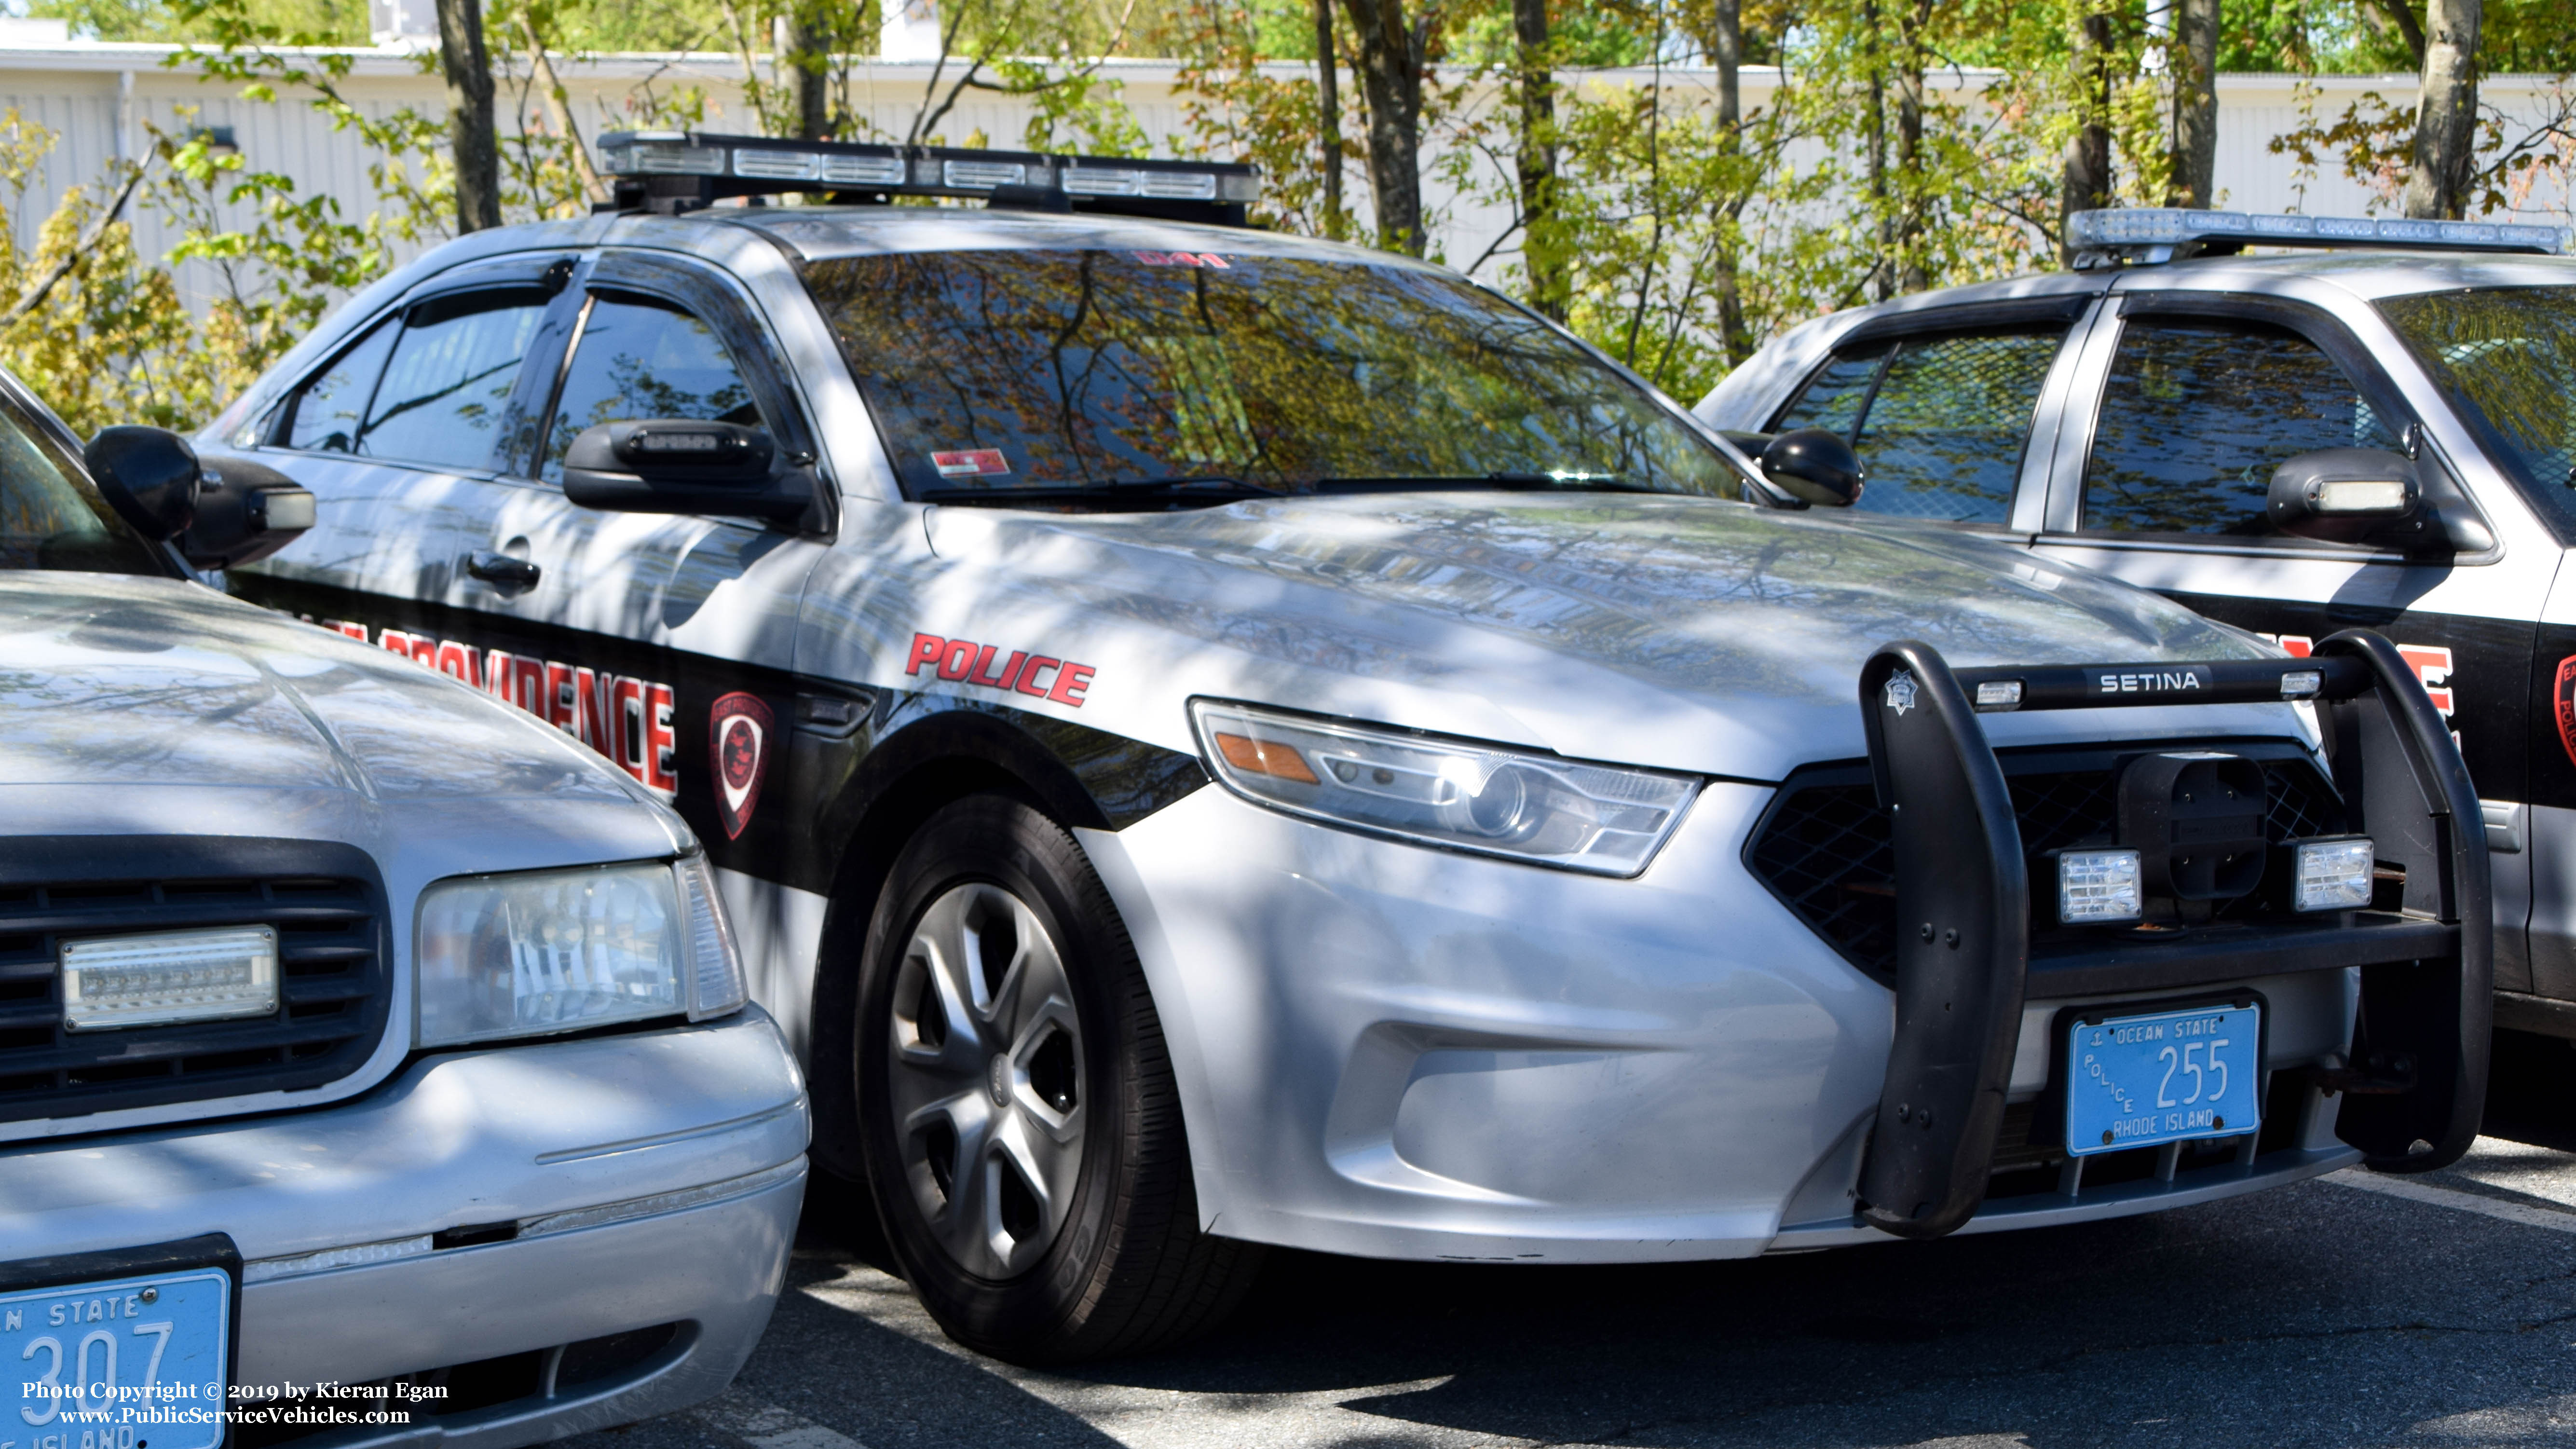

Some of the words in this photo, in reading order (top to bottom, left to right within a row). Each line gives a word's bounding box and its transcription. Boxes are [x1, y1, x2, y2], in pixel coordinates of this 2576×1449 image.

[905, 632, 1096, 708] POLICE
[2100, 672, 2200, 692] SETINA
[379, 629, 678, 800] IDENCE
[2561, 700, 2576, 752] POLIC
[2117, 1025, 2164, 1045] OCEAN
[2175, 1017, 2217, 1038] STATE
[2084, 1053, 2134, 1114] POLICE
[2156, 1039, 2229, 1108] 255
[2113, 1115, 2158, 1138] RHODE
[2166, 1108, 2213, 1132] ISLAND
[50, 1295, 139, 1326] STATE
[21, 1321, 174, 1426] 307
